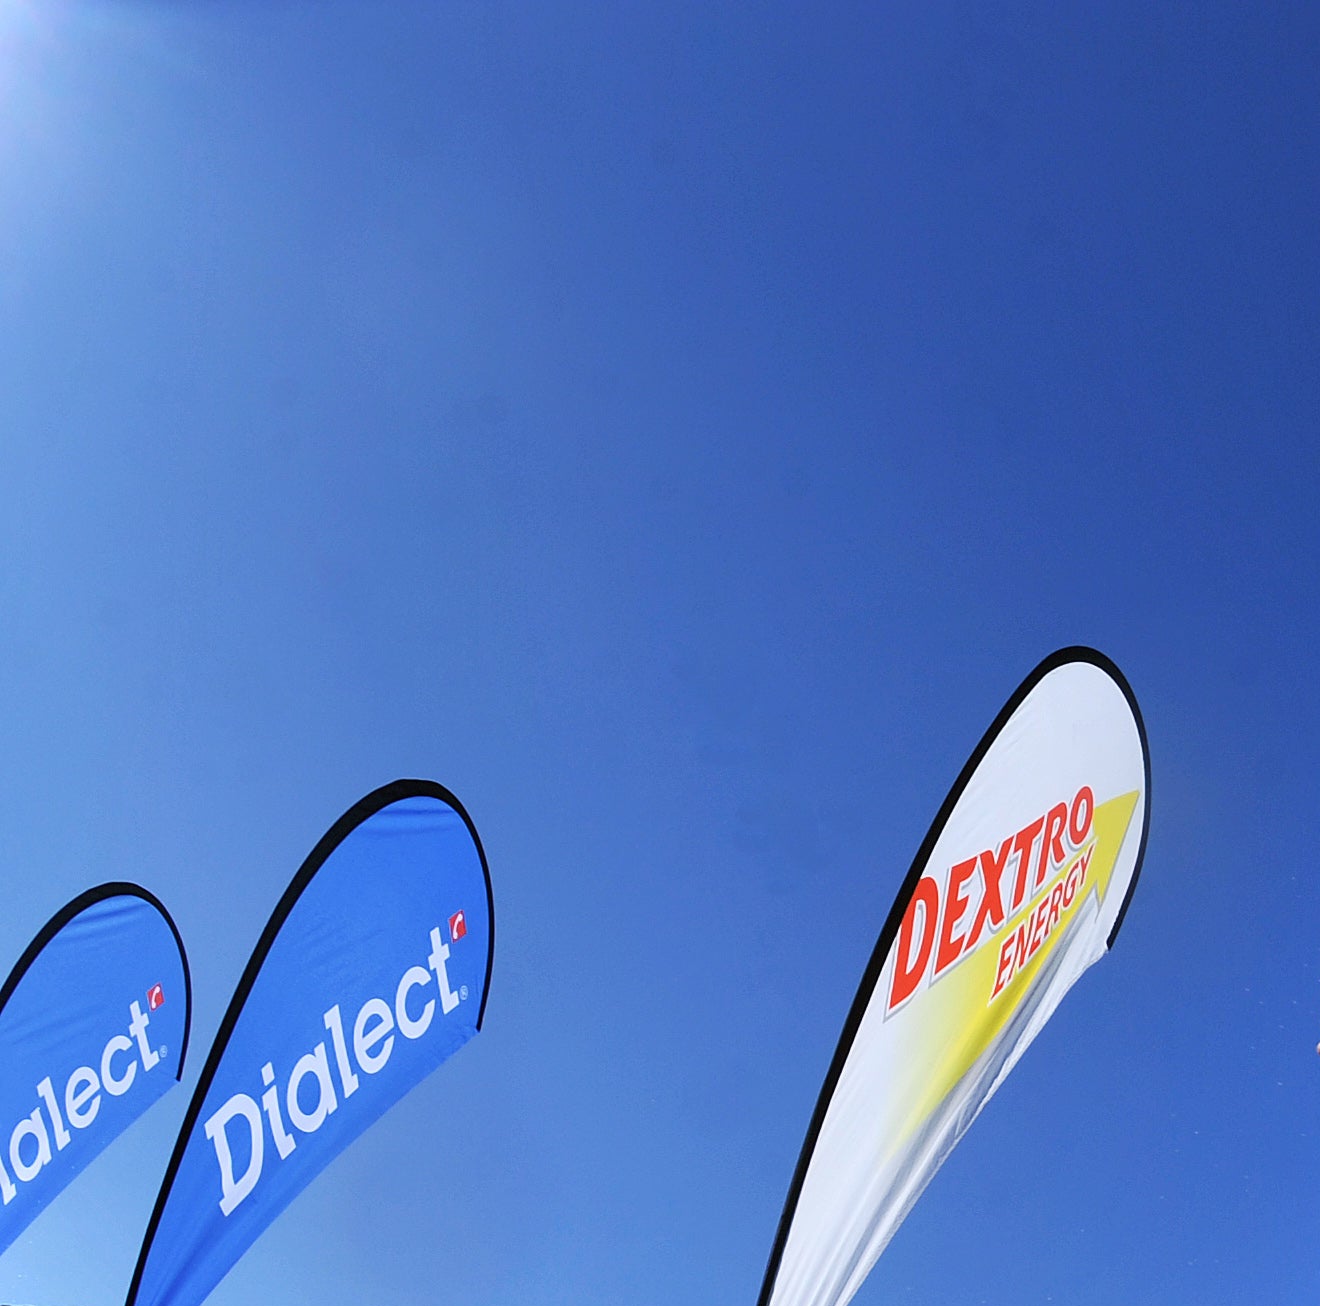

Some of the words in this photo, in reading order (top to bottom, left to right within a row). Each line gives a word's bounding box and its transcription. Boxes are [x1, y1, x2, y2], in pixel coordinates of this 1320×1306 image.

[888, 785, 1095, 1011] DEXTRO
[991, 848, 1095, 1000] ENERGY
[203, 926, 460, 1217] Dialect
